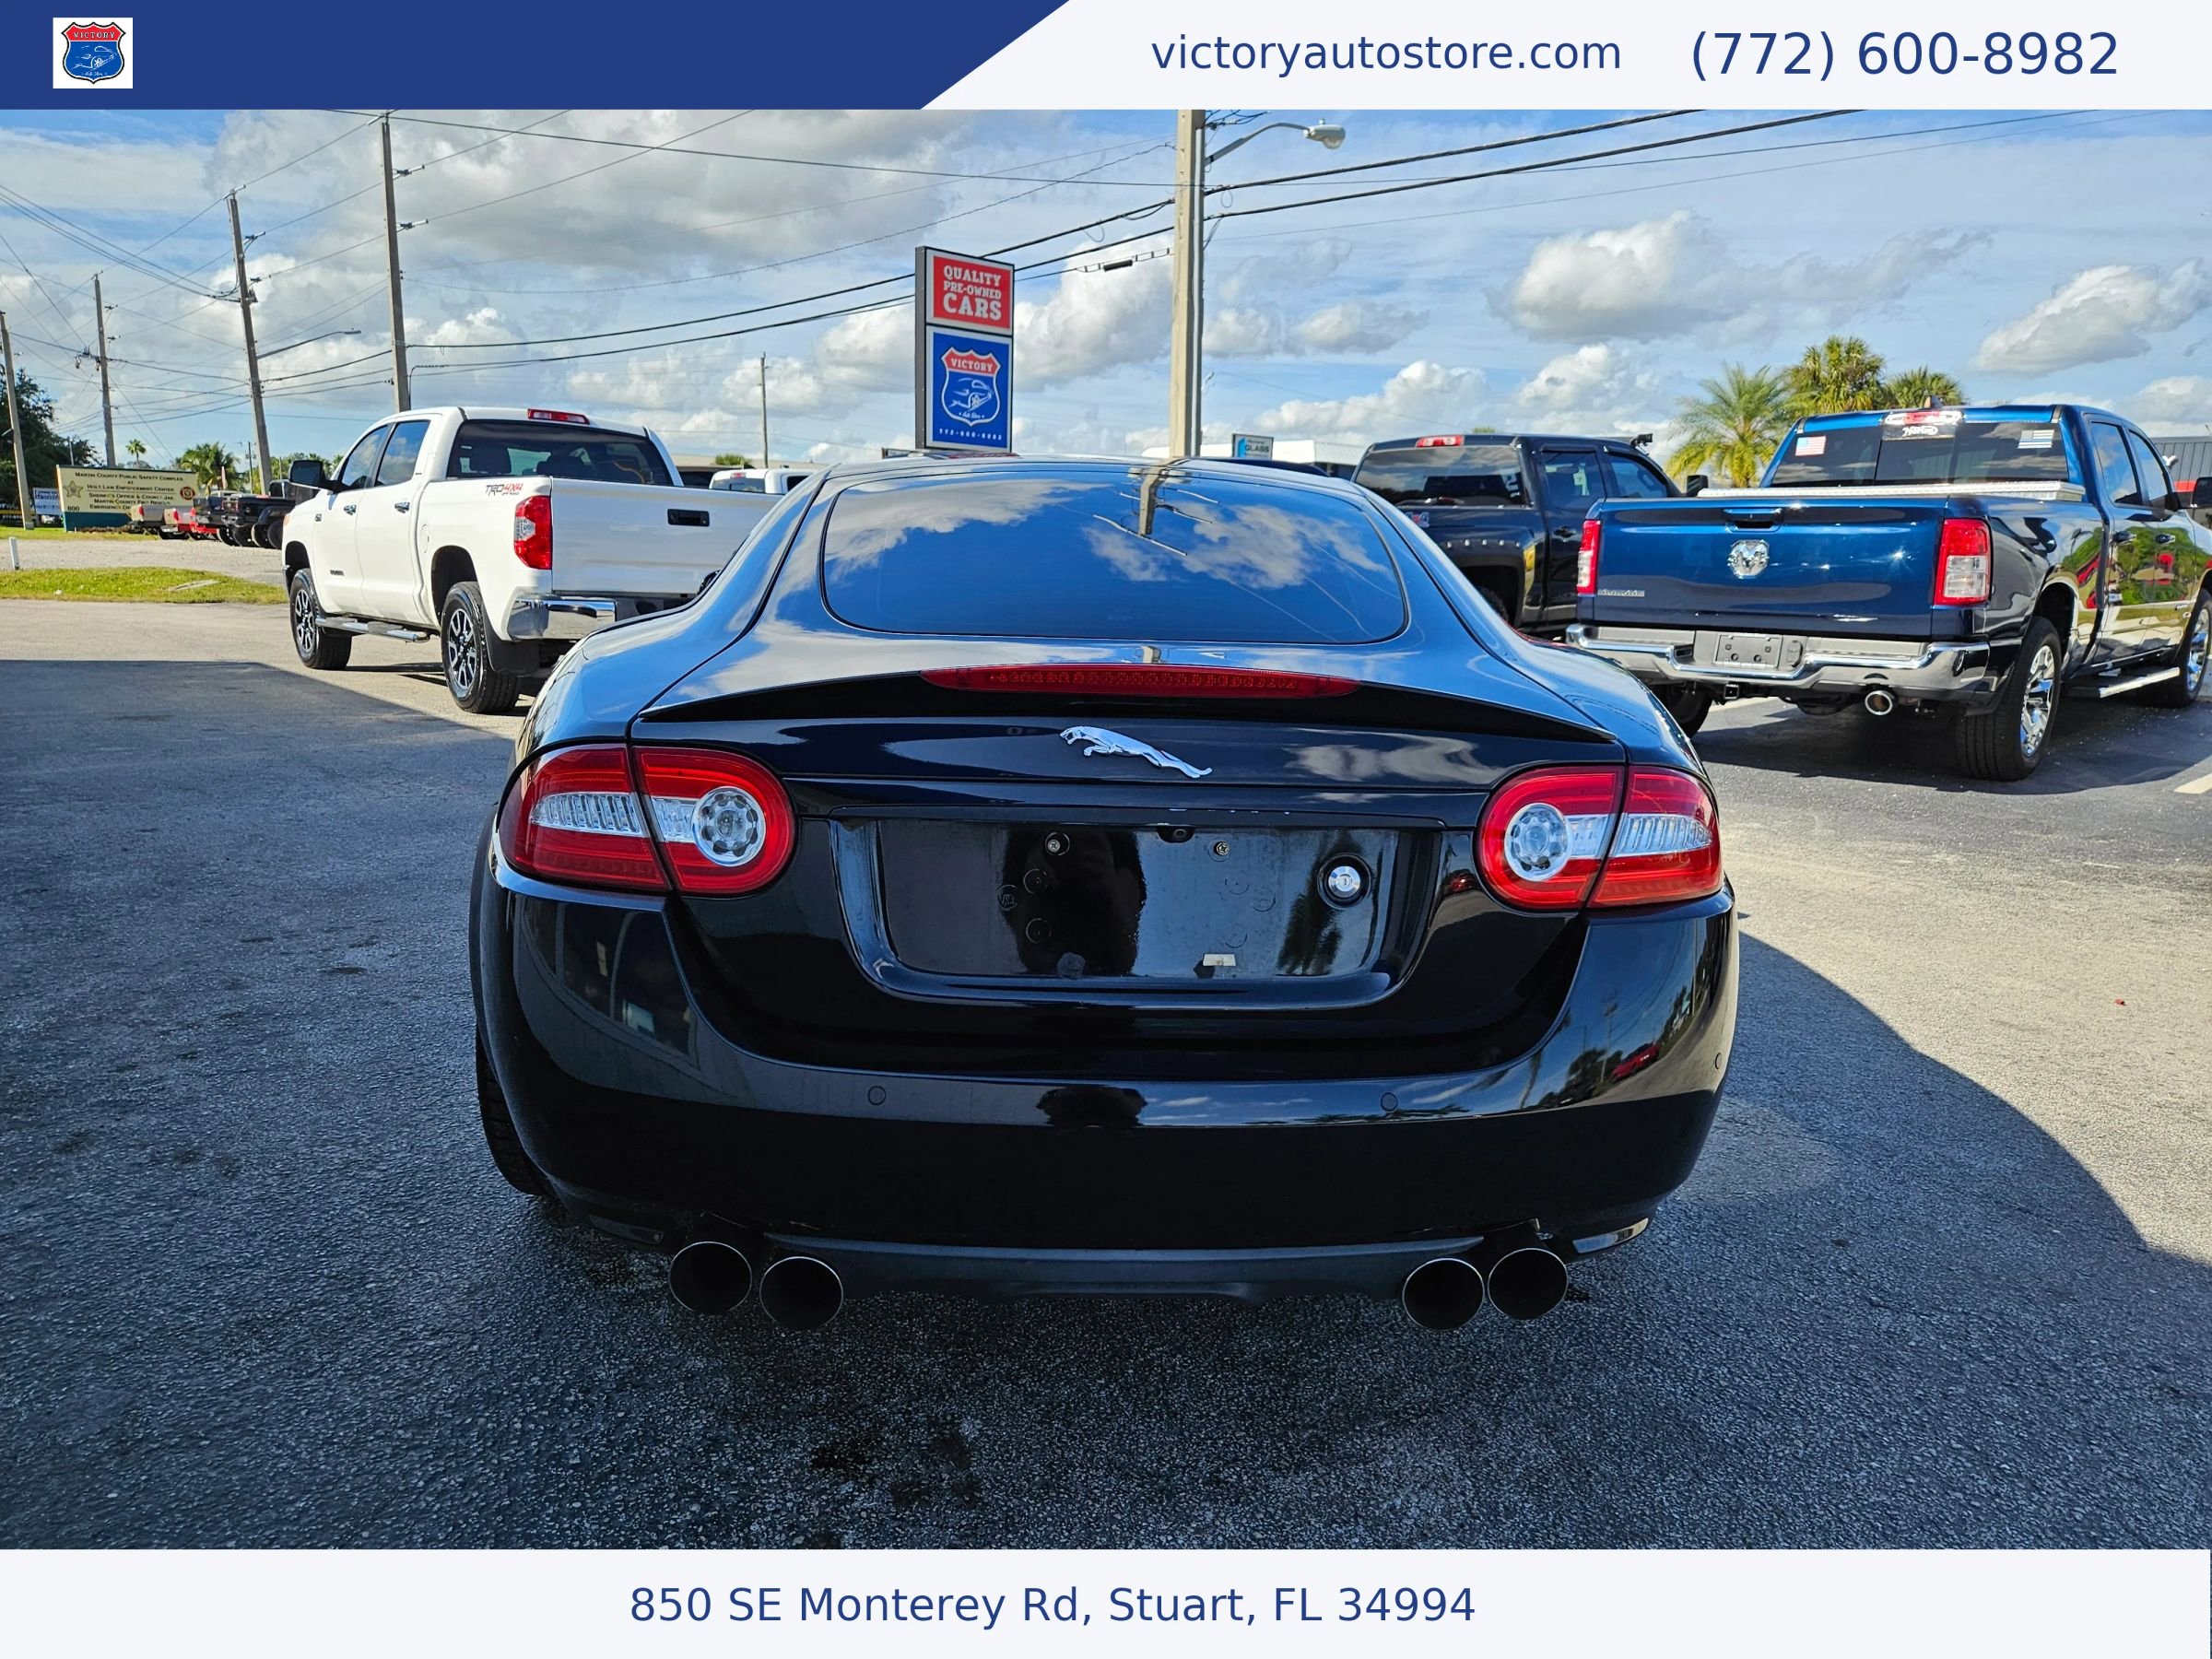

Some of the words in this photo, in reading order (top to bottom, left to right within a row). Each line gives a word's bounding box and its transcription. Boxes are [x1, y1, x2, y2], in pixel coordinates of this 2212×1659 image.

[943, 265, 1002, 287] QUALITY
[943, 280, 1002, 300] PRE-OWNED
[943, 292, 1002, 321] CARS
[950, 357, 994, 372] VICTORY
[1244, 444, 1270, 453] GLASS
[486, 484, 505, 497] TRD
